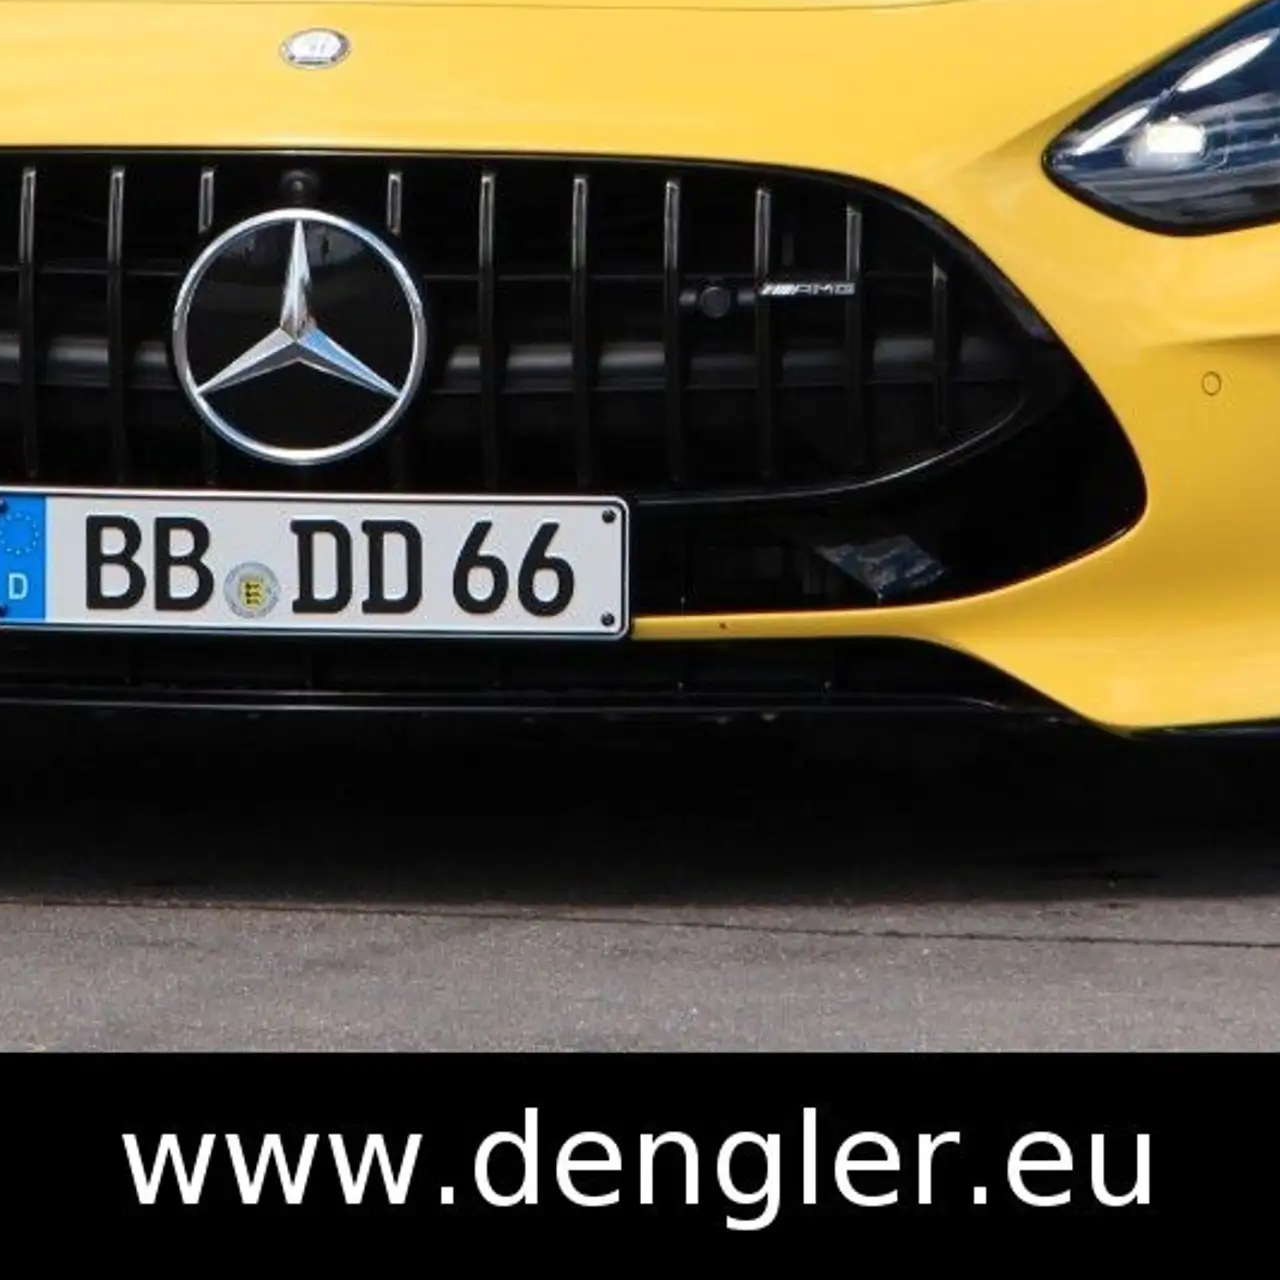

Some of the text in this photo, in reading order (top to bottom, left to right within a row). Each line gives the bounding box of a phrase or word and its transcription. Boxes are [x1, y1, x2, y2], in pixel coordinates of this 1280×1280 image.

[8, 572, 28, 600] D
[85, 515, 575, 618] BB DD 66
